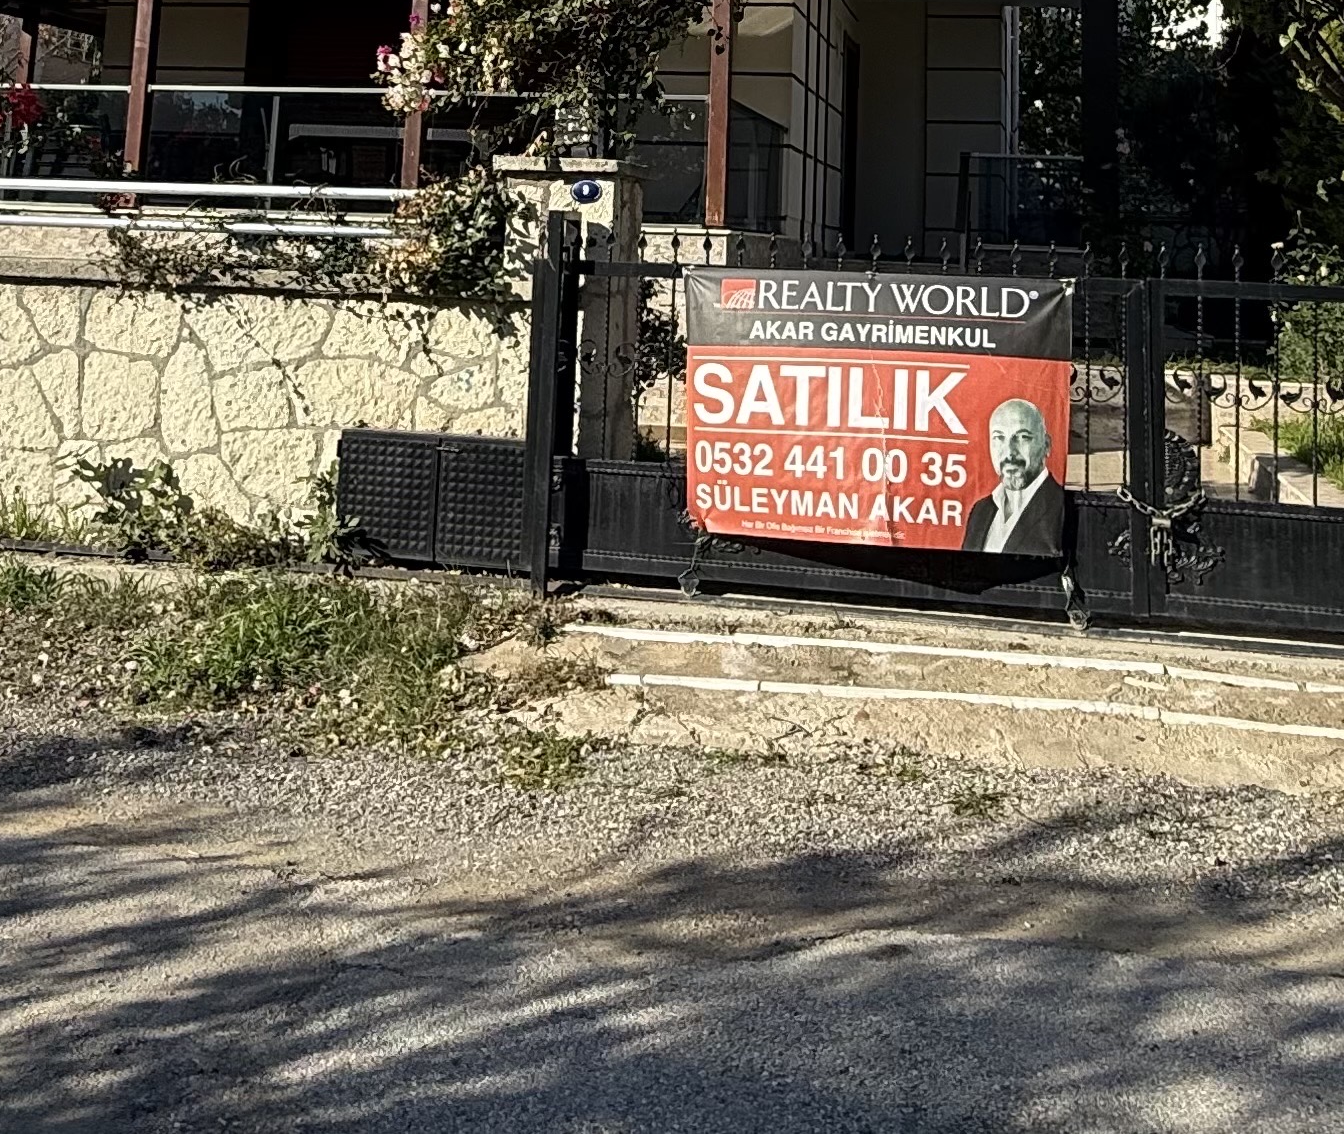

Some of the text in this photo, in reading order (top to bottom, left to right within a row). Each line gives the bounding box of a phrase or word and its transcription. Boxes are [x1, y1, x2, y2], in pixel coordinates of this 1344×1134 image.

[757, 279, 1030, 318] REALTY WORLD
[749, 319, 997, 349] AKAR GAYRİMENKUL
[693, 363, 969, 435] SATILIK
[694, 439, 967, 489] 0532 441 00 35
[696, 479, 963, 527] SÜLEYMAN AKAR
